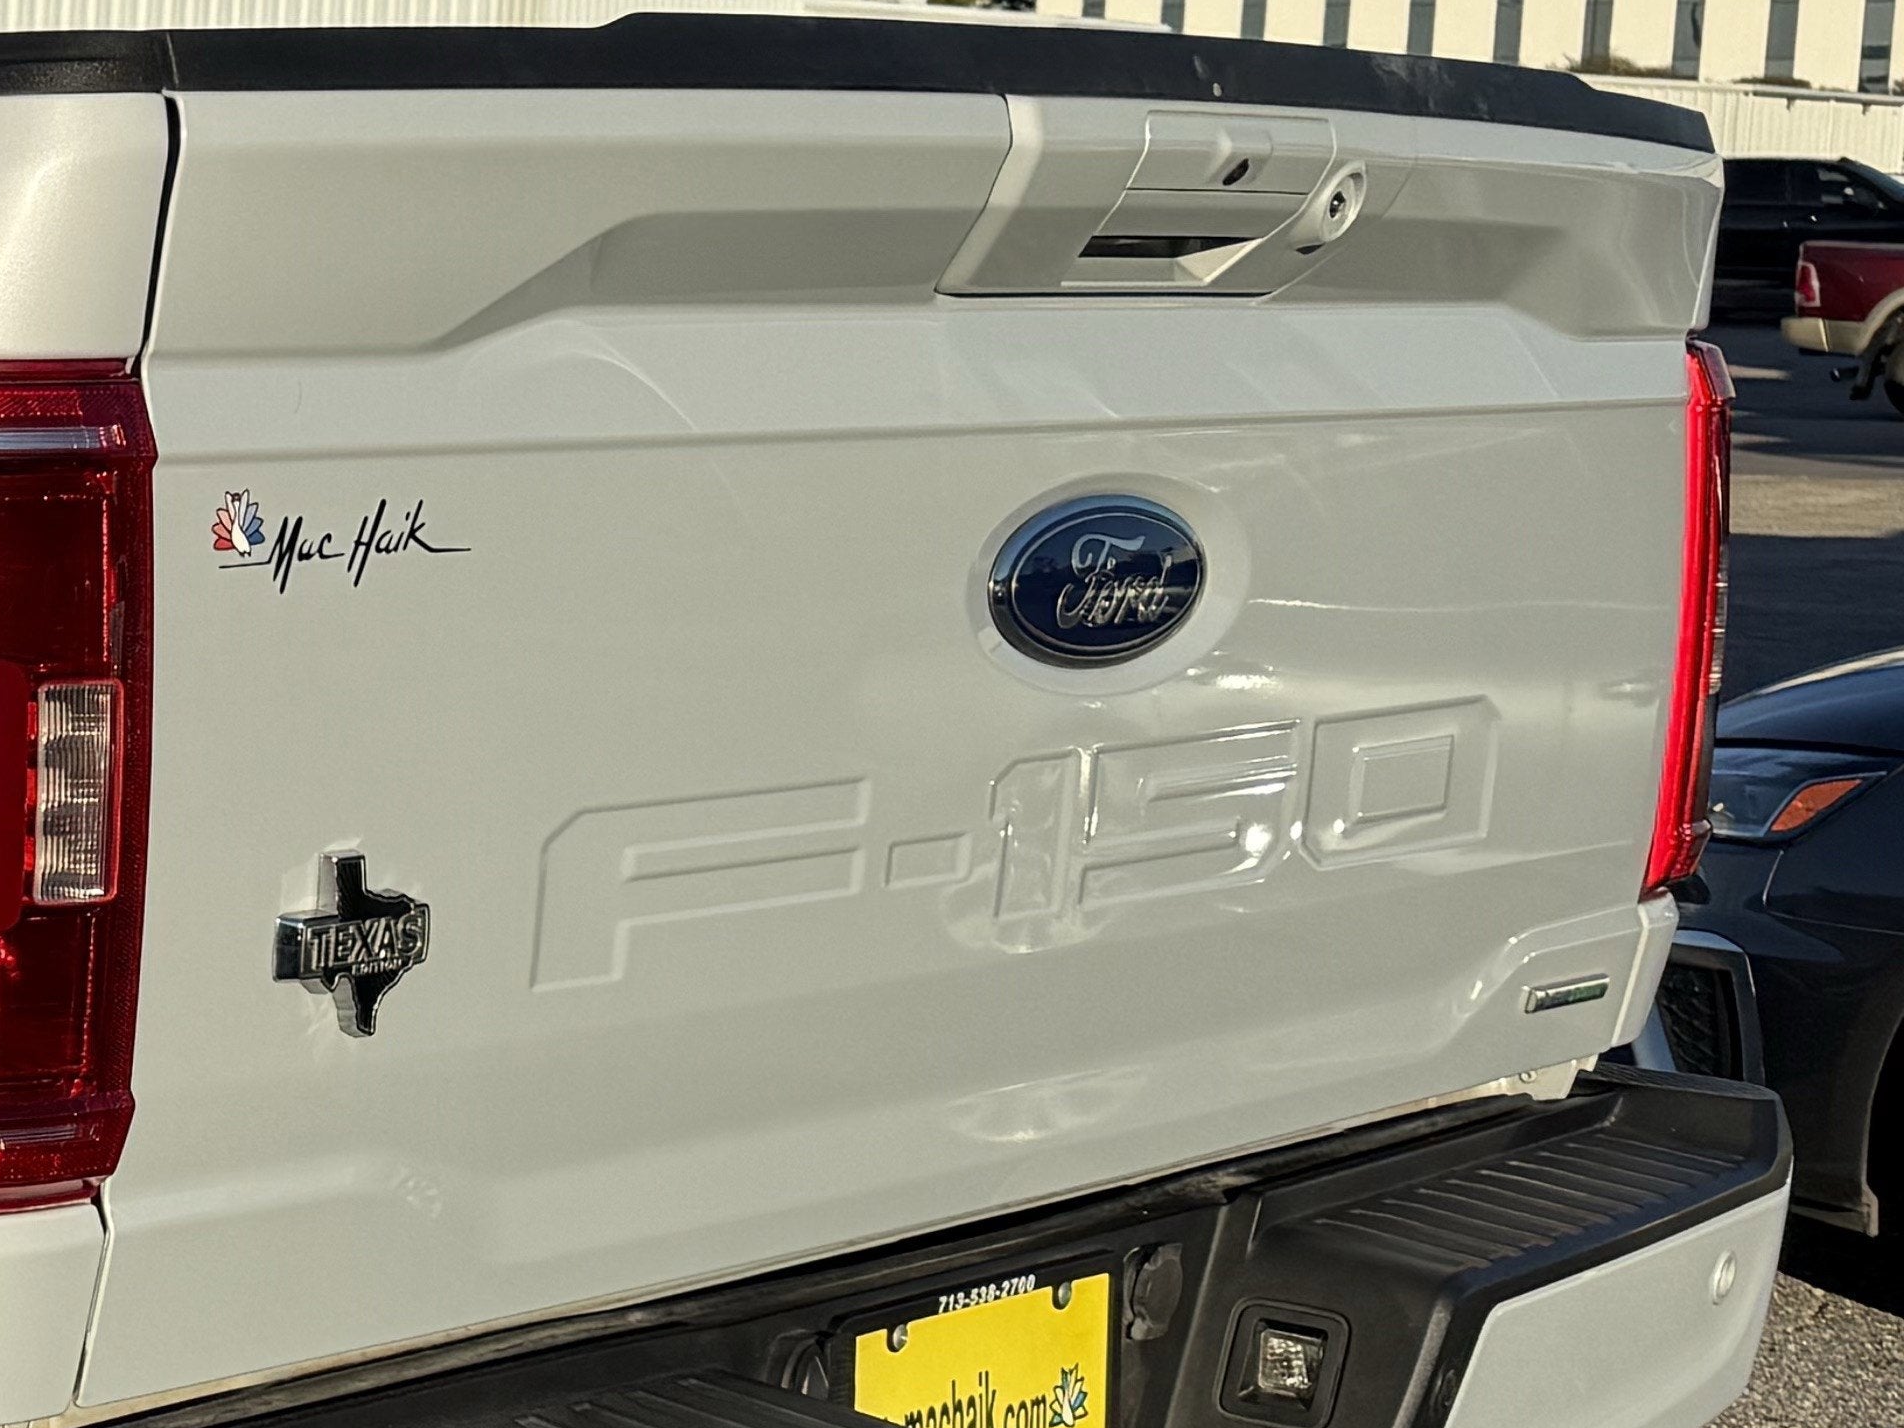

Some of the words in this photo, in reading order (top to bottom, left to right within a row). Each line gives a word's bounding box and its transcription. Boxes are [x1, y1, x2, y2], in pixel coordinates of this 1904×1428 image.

[218, 515, 345, 595] Mac
[347, 498, 472, 588] Haik
[1056, 532, 1173, 630] Ford
[531, 695, 1500, 993] F-150
[304, 913, 425, 972] TEXAS
